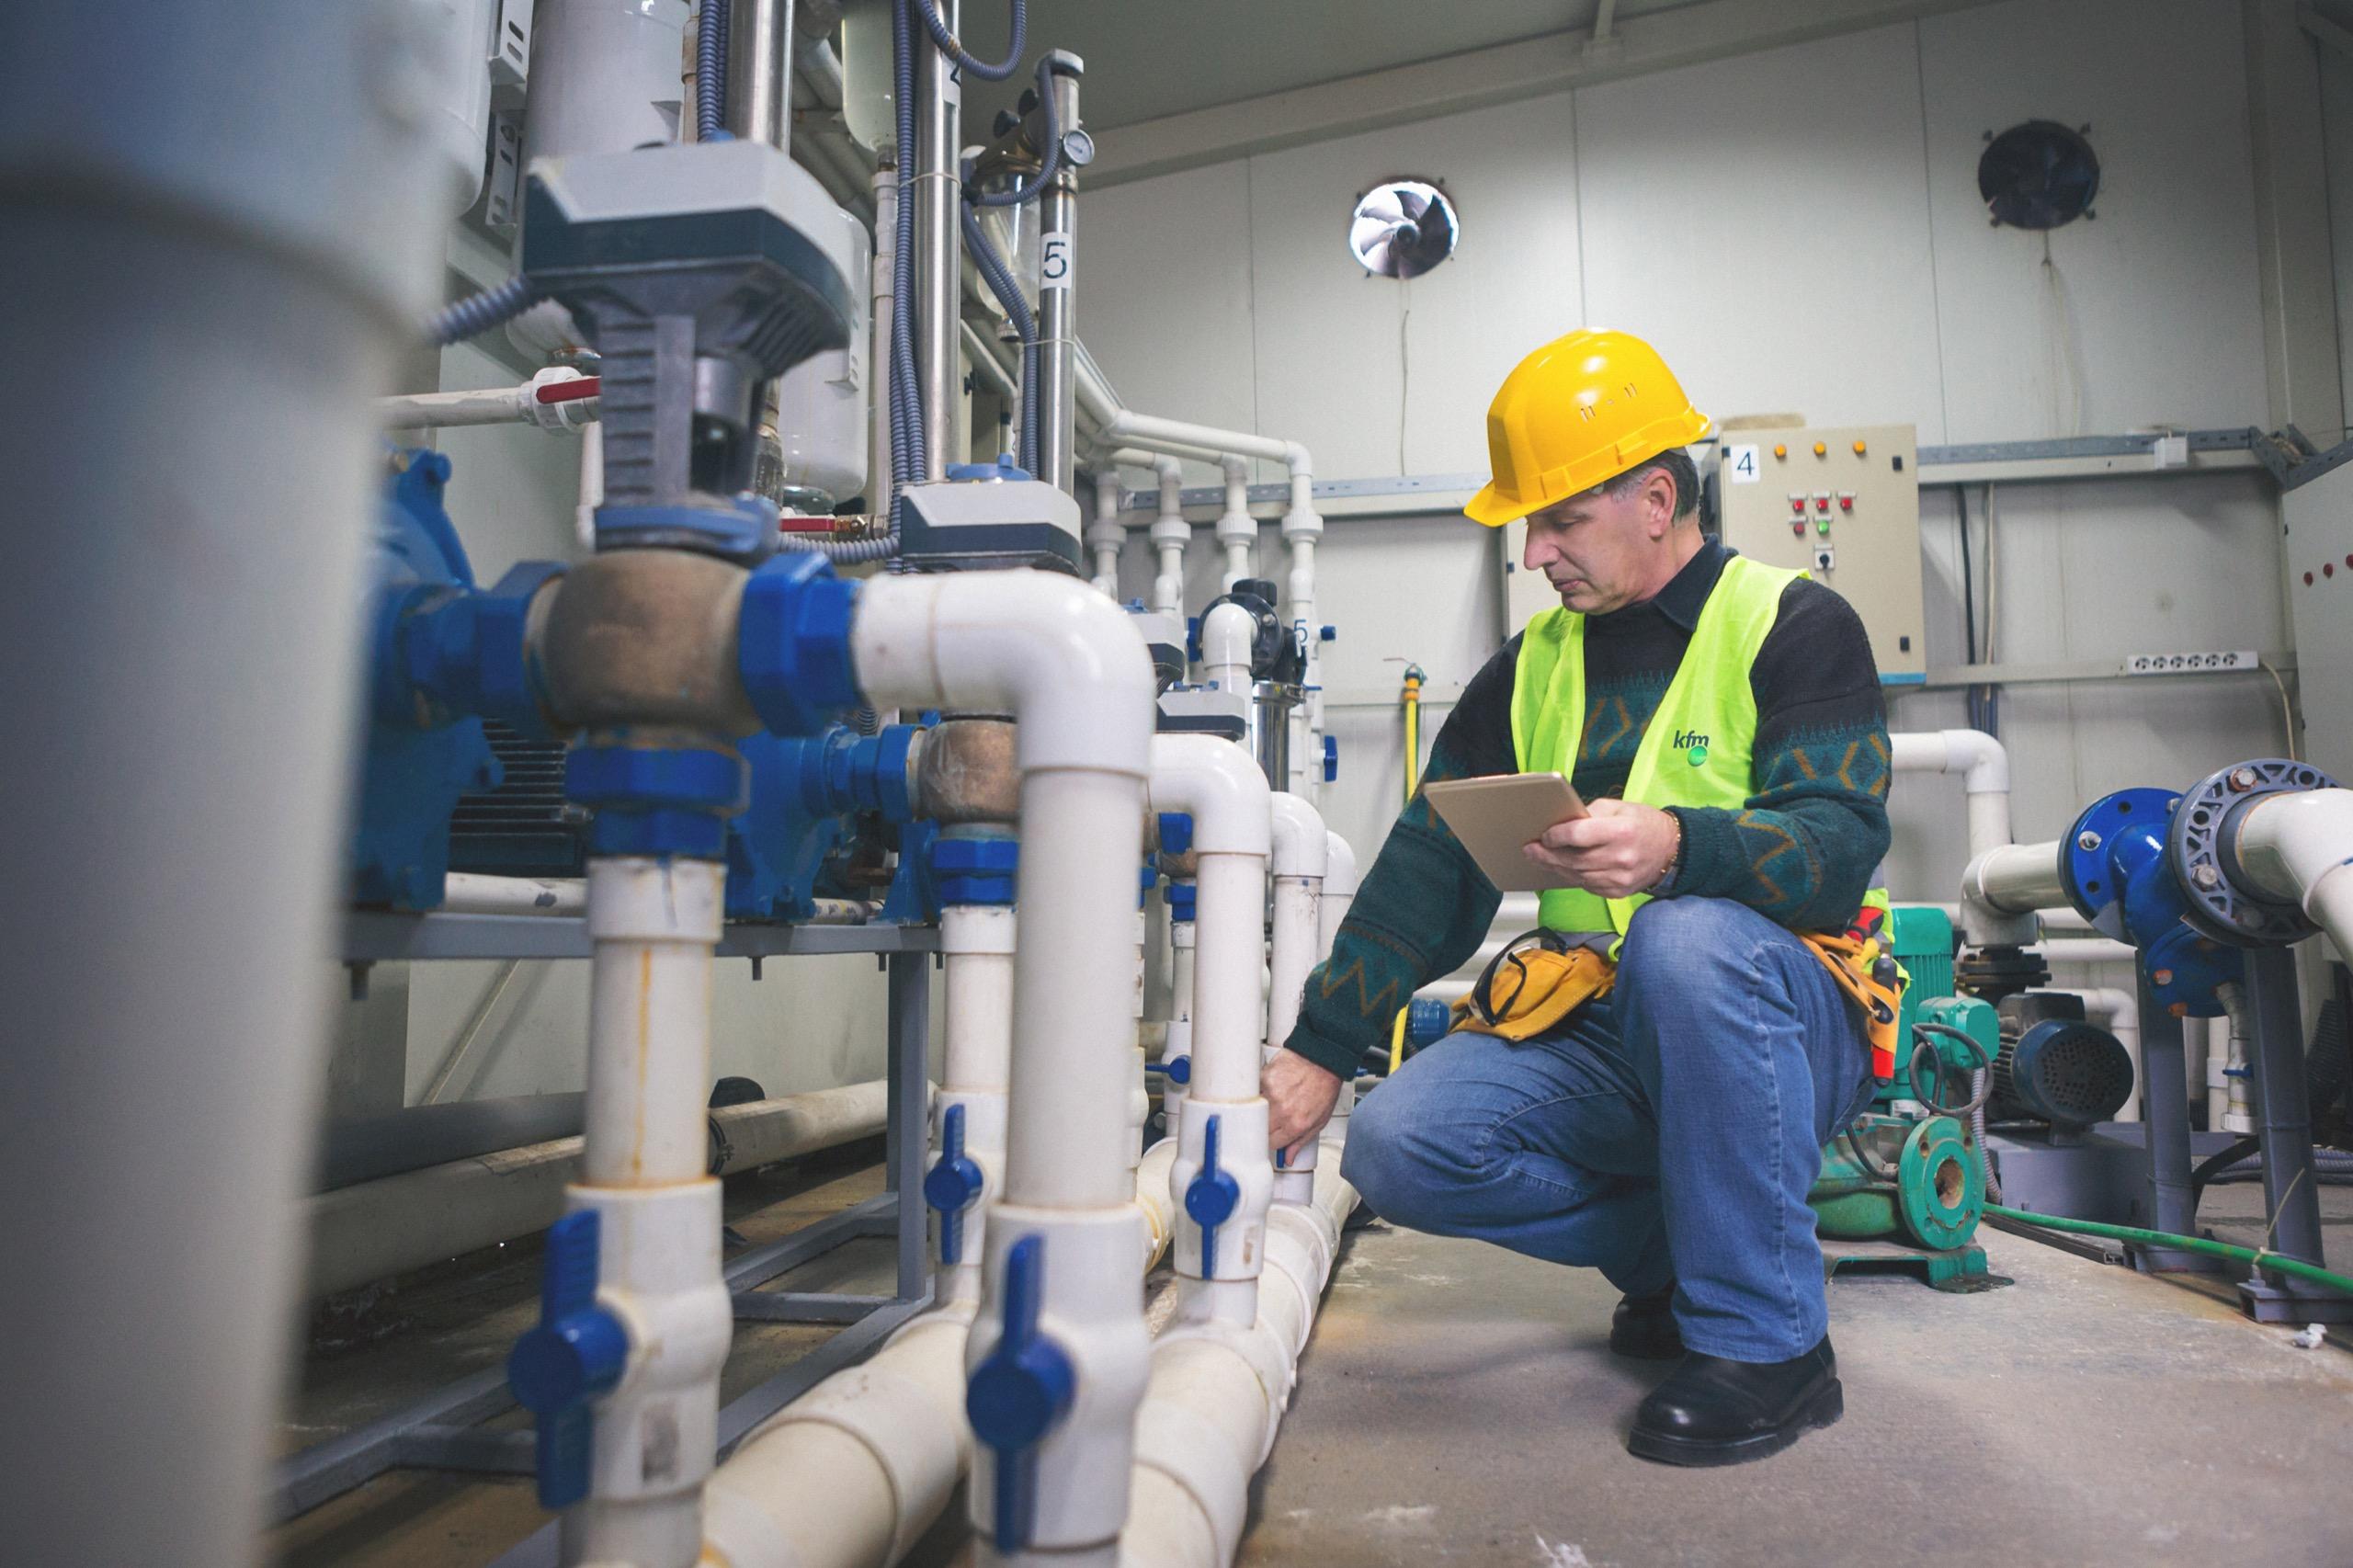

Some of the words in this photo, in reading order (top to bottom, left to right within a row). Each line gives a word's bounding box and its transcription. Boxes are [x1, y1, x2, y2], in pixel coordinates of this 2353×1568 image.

[1043, 241, 1067, 279] 5
[1737, 451, 1755, 476] 4
[1294, 619, 1308, 643] 5
[1673, 730, 1709, 749] kfm
